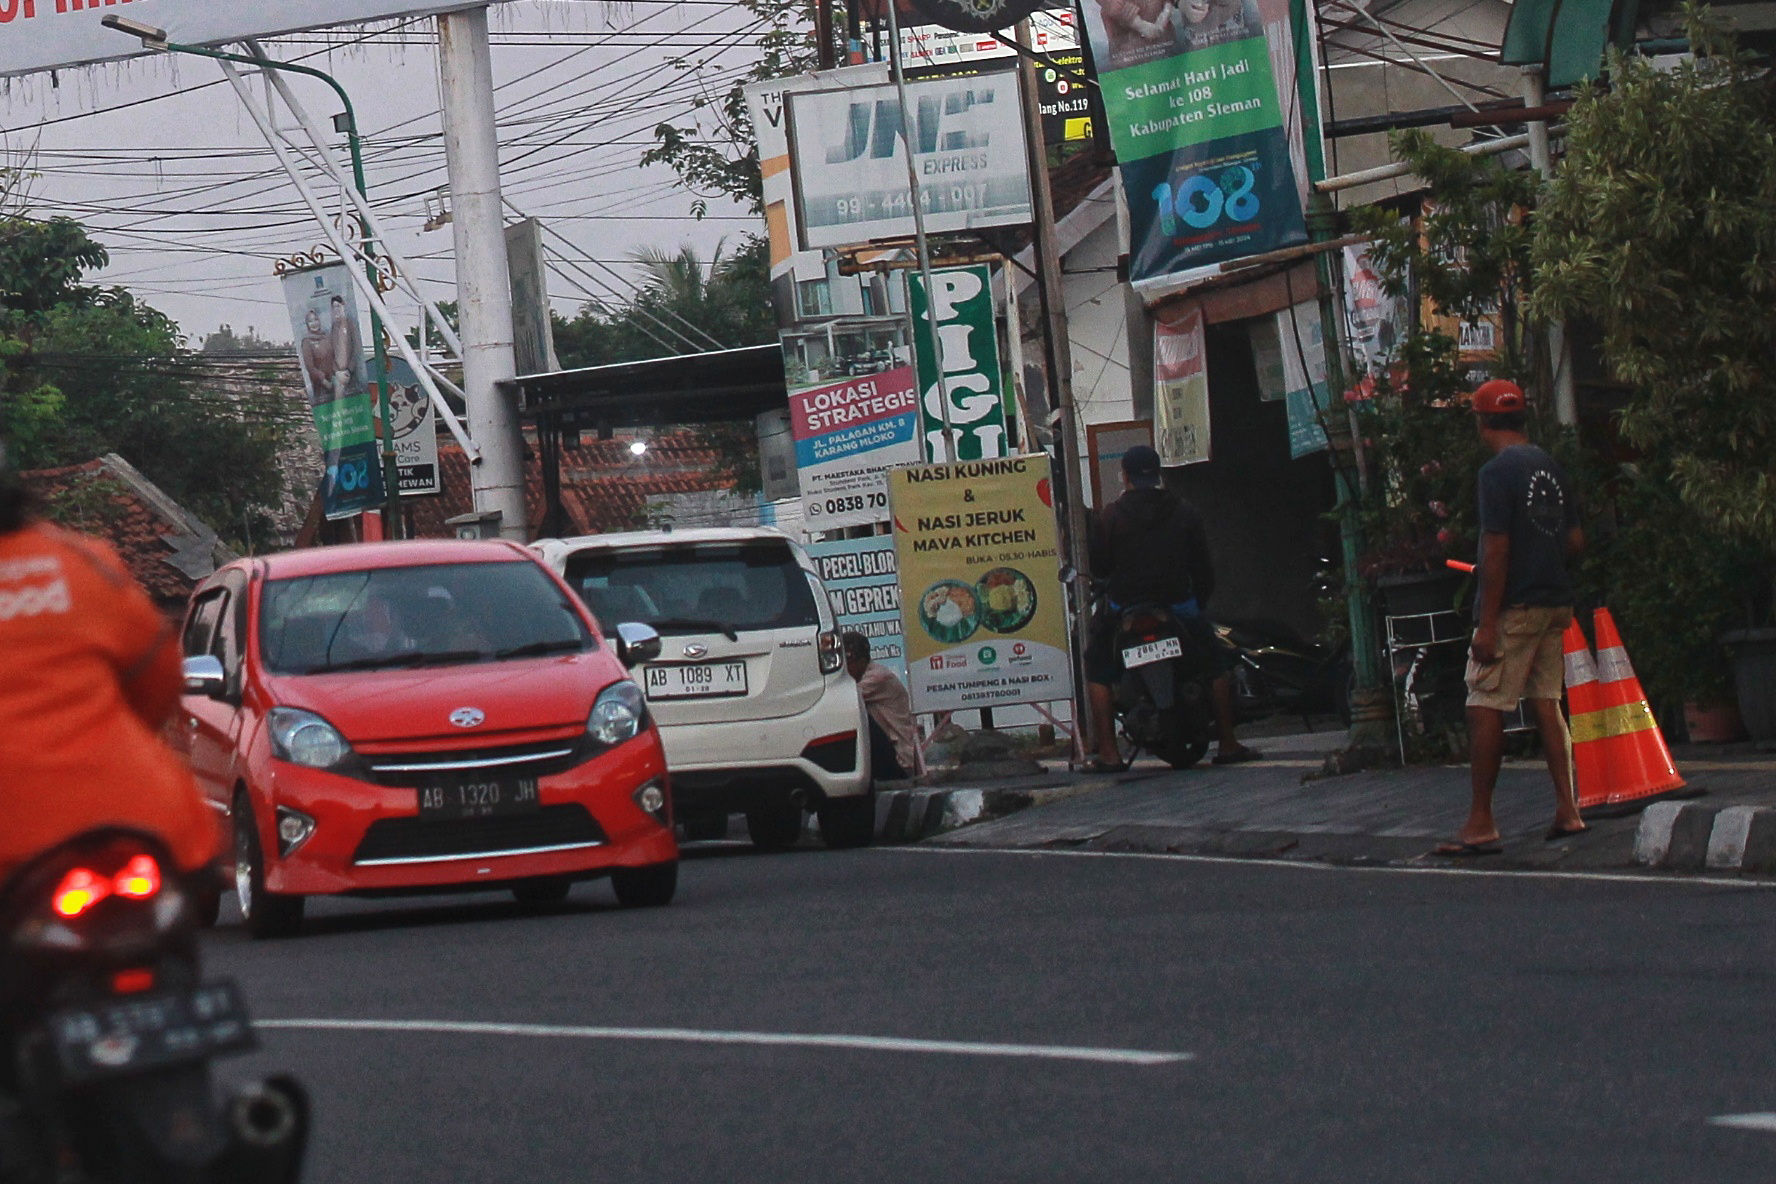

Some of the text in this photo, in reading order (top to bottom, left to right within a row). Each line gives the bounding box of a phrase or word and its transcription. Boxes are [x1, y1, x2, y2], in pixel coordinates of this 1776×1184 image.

[1125, 59, 1249, 100] Selamat Hari Jadi
[761, 90, 790, 104] TH
[1169, 86, 1212, 109] ke 108
[1038, 102, 1057, 116] lang
[1129, 97, 1262, 138] Kabupaten Sleman
[826, 89, 995, 164] JNE
[924, 153, 988, 176] EXPRESS
[1151, 165, 1261, 236] 108
[802, 381, 878, 413] LOKASI
[807, 388, 916, 430] STRATEGIS
[813, 440, 826, 449] JL.
[828, 426, 876, 445] PALAGAN
[878, 422, 896, 433] KM.
[815, 432, 895, 458] KARANG MLOKO
[907, 460, 1027, 483] NASI KUNING
[826, 493, 887, 514] 0838 70
[964, 488, 974, 502] &
[918, 508, 1025, 531] NASI JERUK
[913, 529, 1036, 552] MAVA KITCHEN
[823, 554, 862, 579] PECEL
[650, 665, 742, 687] AB 1089 XT
[926, 683, 956, 693] PESAN
[958, 679, 1000, 690] TUMPENG
[1009, 677, 1029, 685] NASI
[1031, 674, 1049, 683] BOX
[423, 787, 443, 808] AB
[459, 782, 500, 805] 1320
